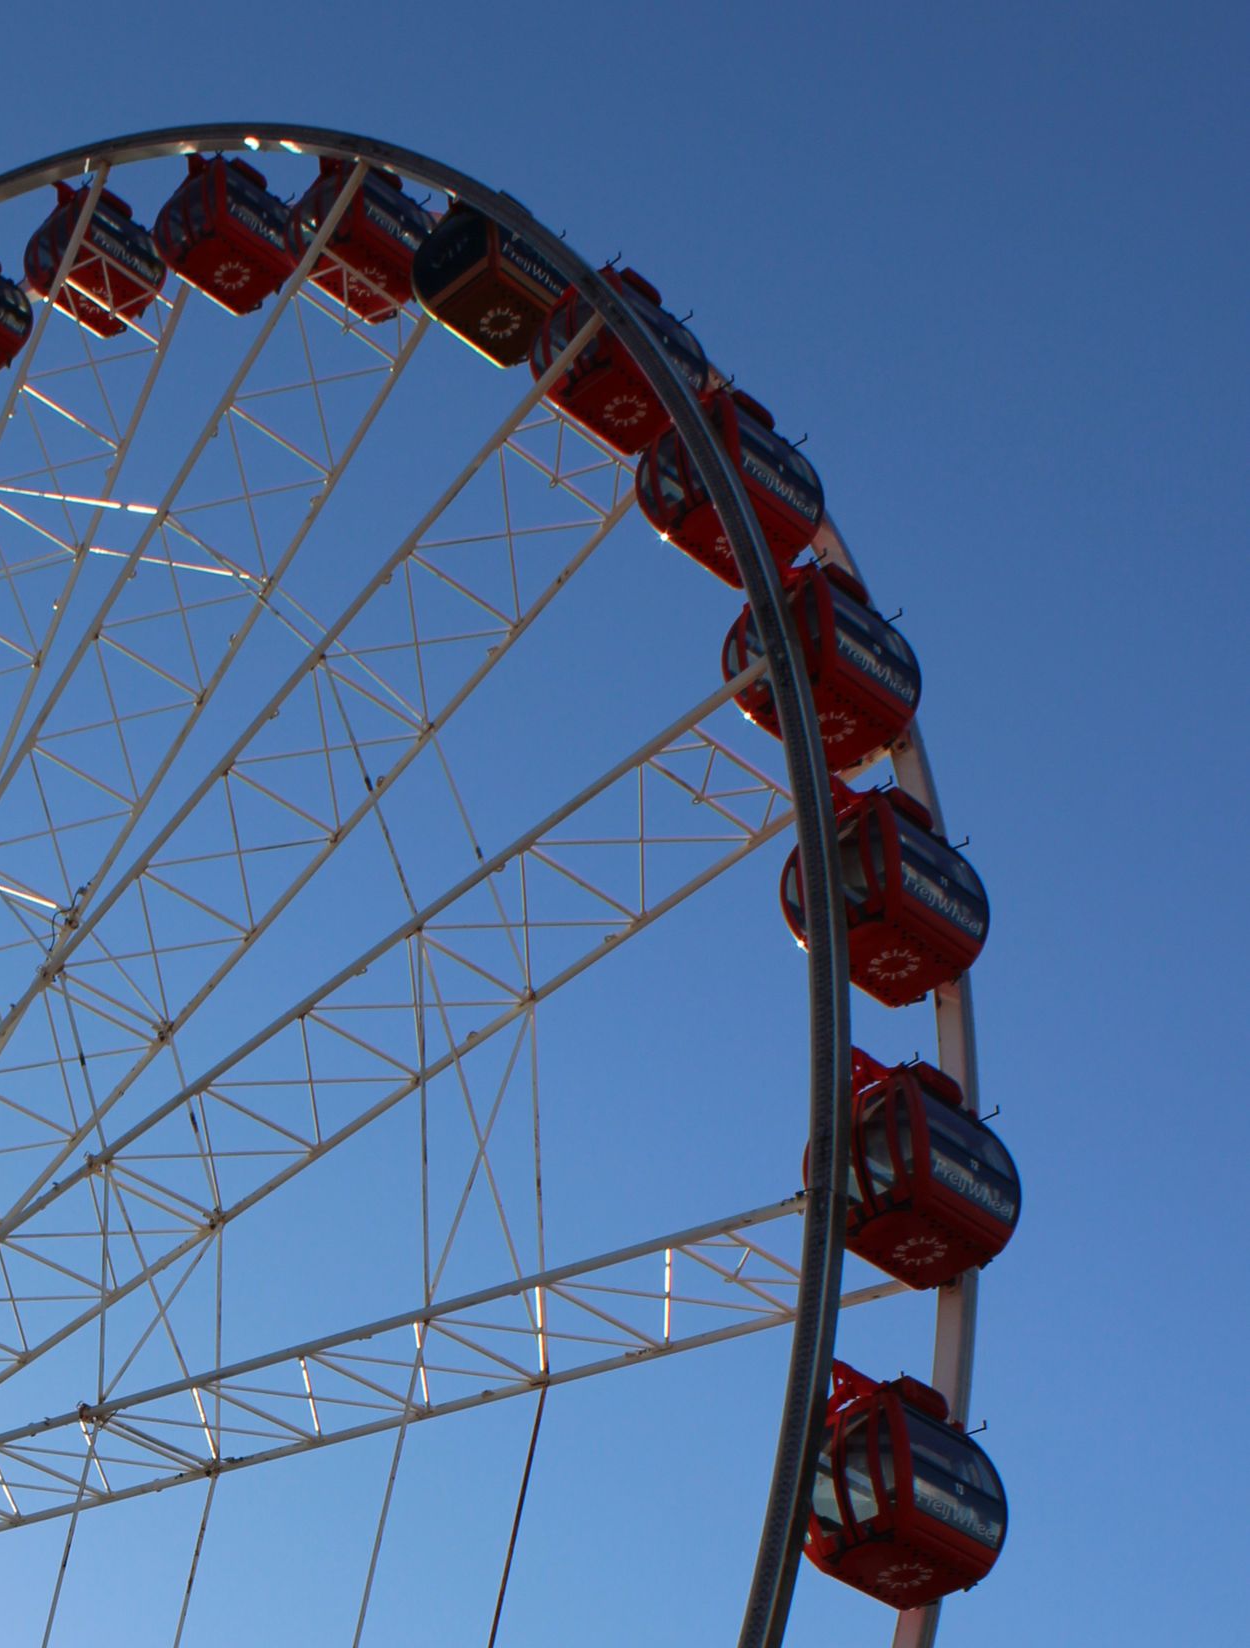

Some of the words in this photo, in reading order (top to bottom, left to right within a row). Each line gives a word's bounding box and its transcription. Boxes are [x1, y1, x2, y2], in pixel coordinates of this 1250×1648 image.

[904, 873, 982, 936] FreijWheel
[934, 1159, 1014, 1219] FreijWheel
[916, 1494, 999, 1542] FreijWheel
